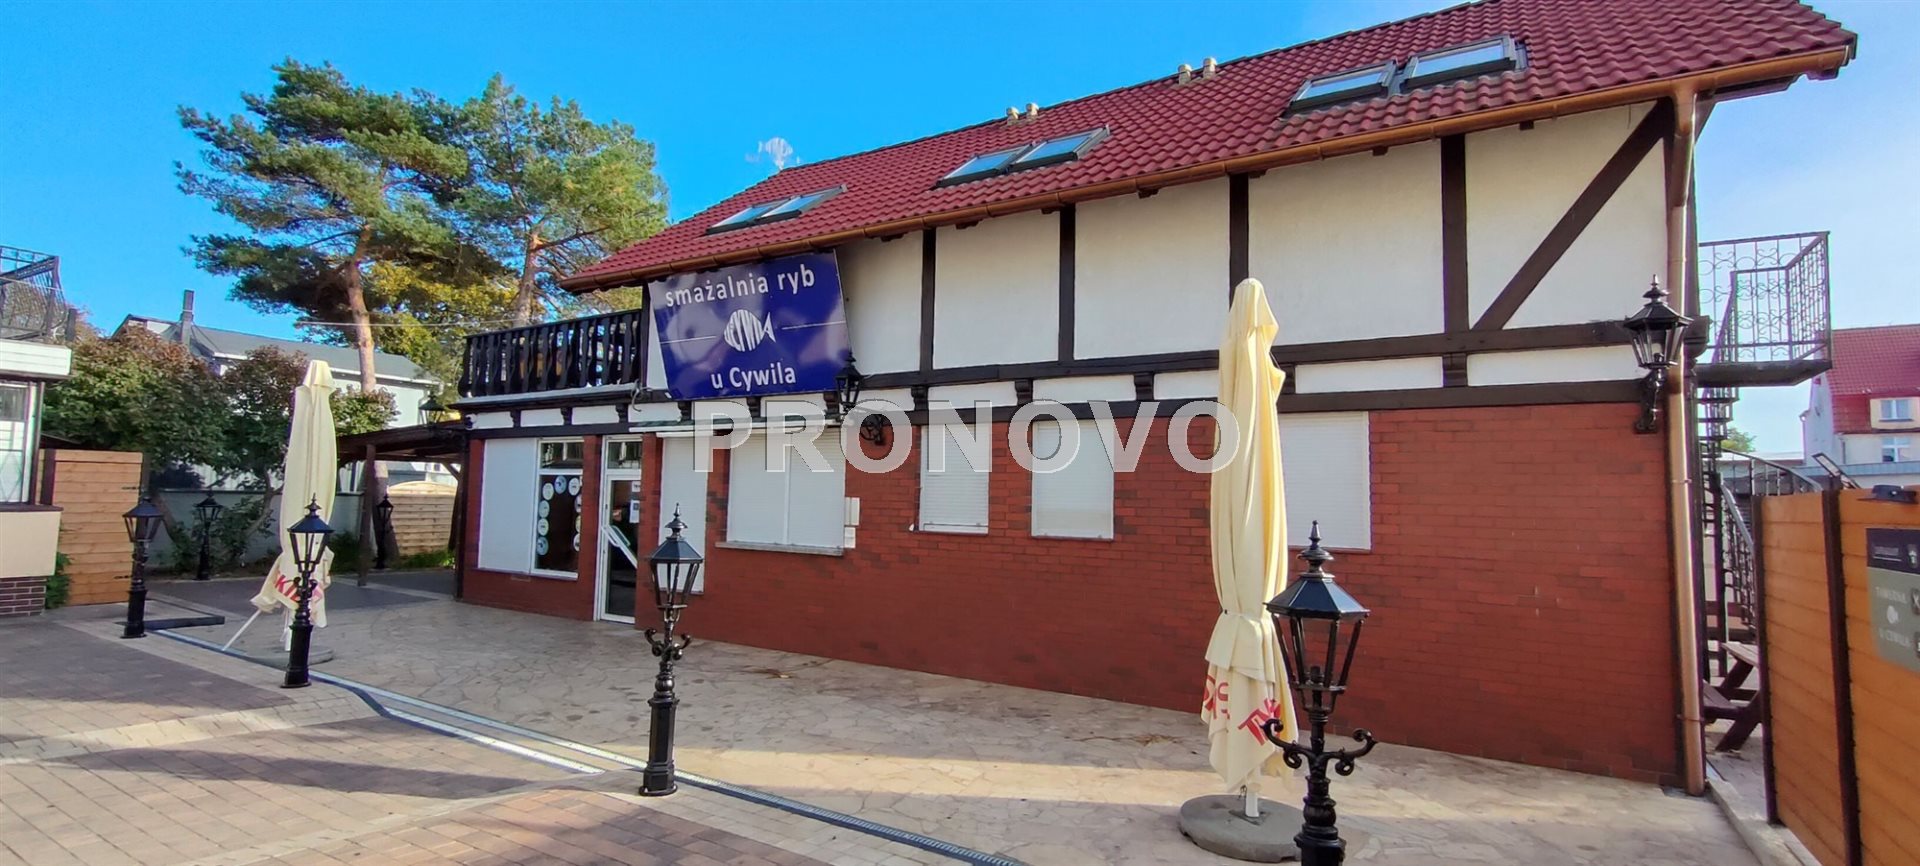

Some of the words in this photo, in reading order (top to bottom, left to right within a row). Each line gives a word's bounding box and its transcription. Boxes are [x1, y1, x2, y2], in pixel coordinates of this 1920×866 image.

[665, 273, 769, 307] smażalnia
[777, 263, 816, 295] ryb
[711, 373, 723, 390] u
[729, 362, 797, 392] Cywila
